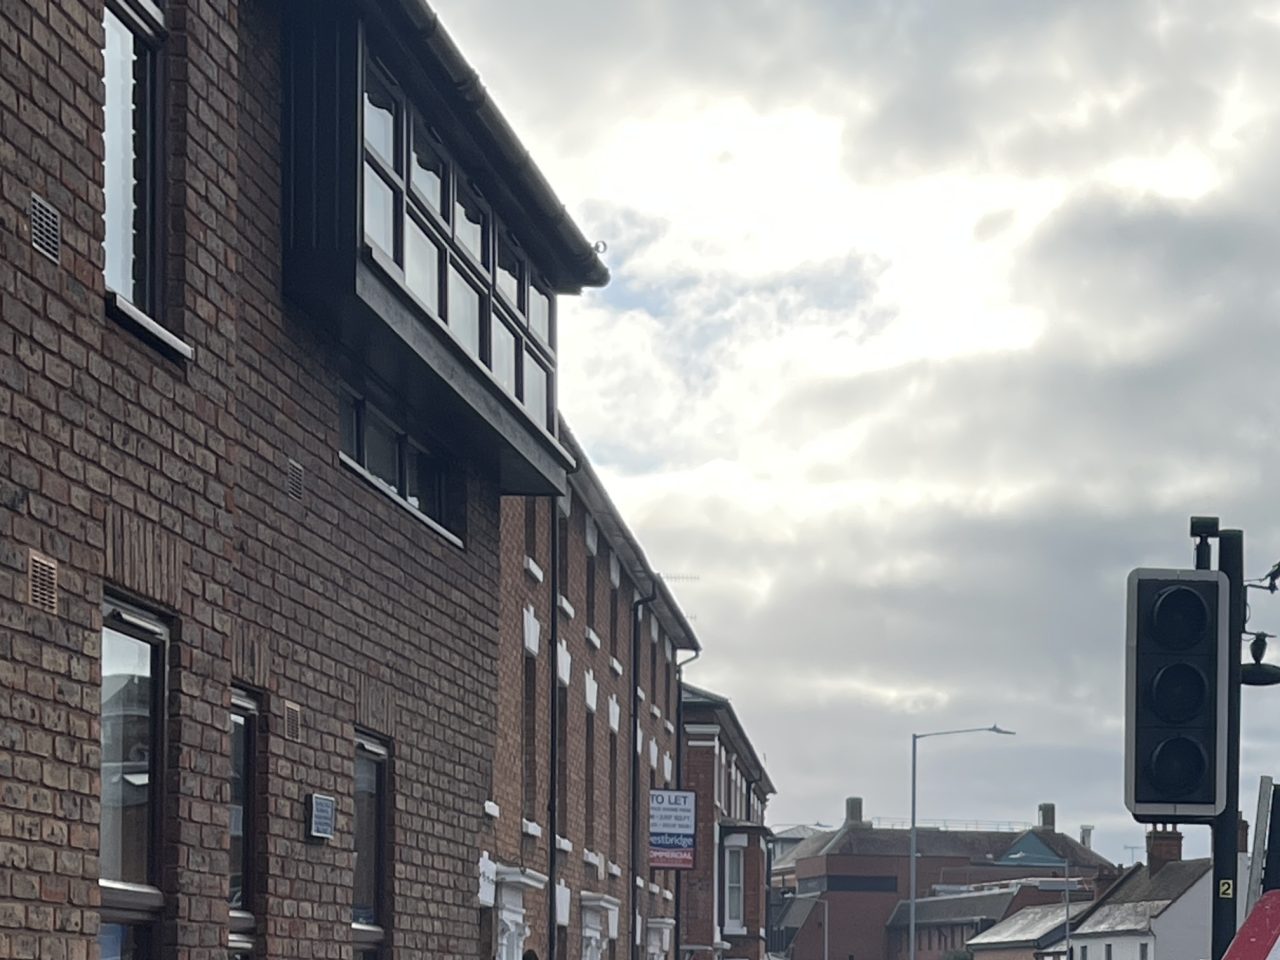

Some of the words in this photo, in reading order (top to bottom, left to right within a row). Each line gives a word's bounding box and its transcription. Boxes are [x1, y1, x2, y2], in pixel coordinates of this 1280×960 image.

[651, 793, 664, 805] TO
[668, 794, 688, 806] LET
[650, 833, 693, 848] estbridge
[1221, 881, 1231, 896] 2
